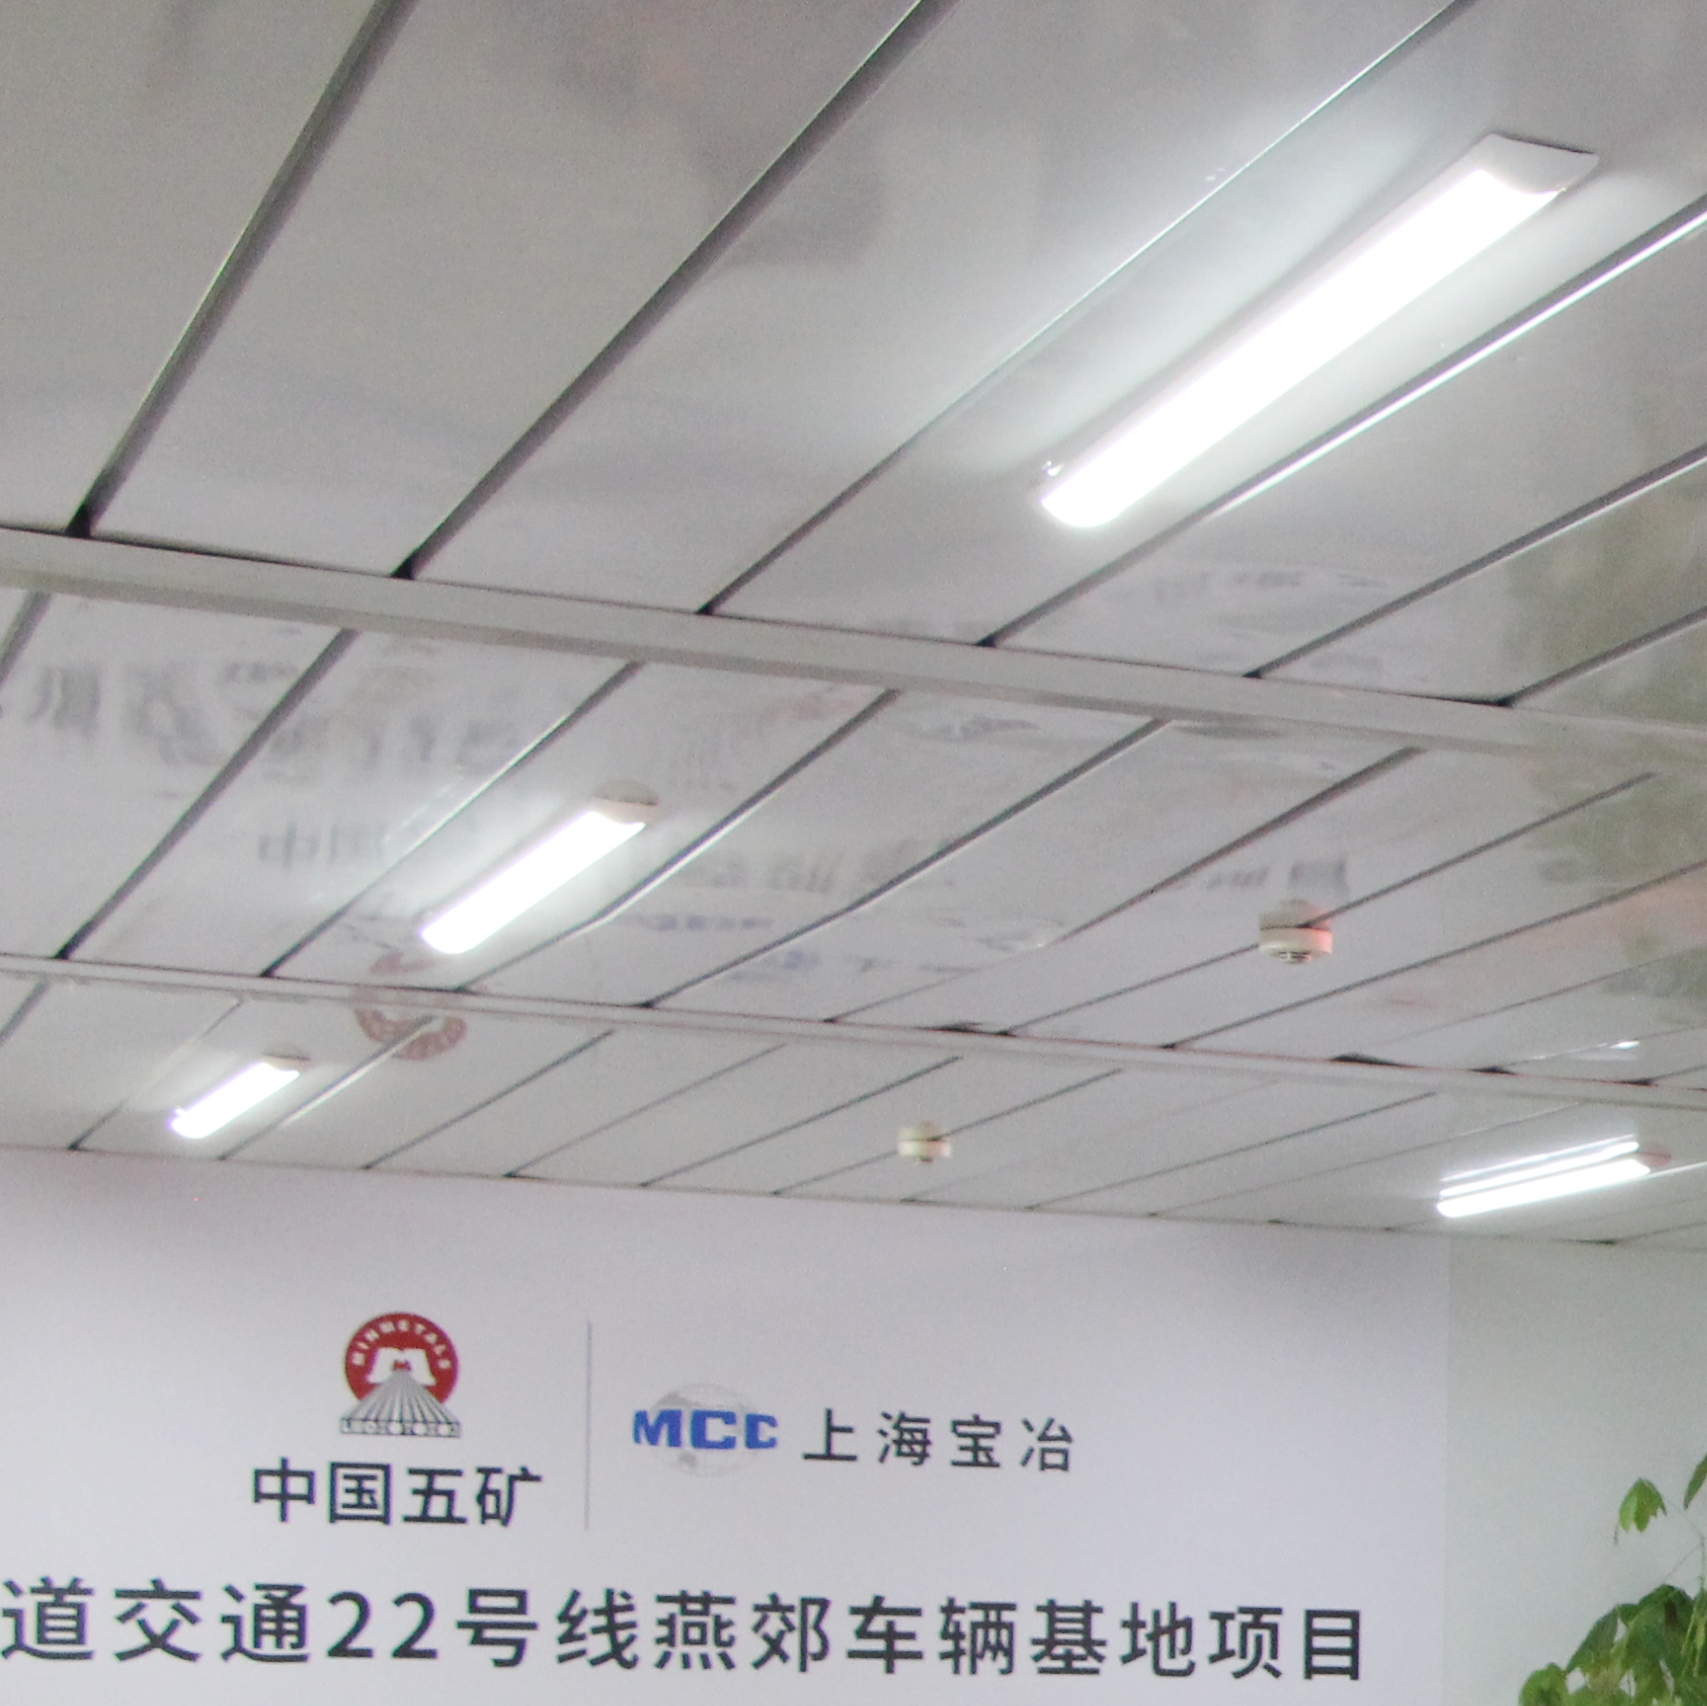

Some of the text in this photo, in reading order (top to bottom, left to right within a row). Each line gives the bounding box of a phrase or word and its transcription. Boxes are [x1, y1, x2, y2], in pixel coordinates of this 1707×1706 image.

[633, 1407, 1073, 1472] MCC 上海宝冶
[252, 1456, 542, 1527] 中国五矿
[0, 1576, 1363, 1681] 道交通22号线燕郊车辆基地项目
